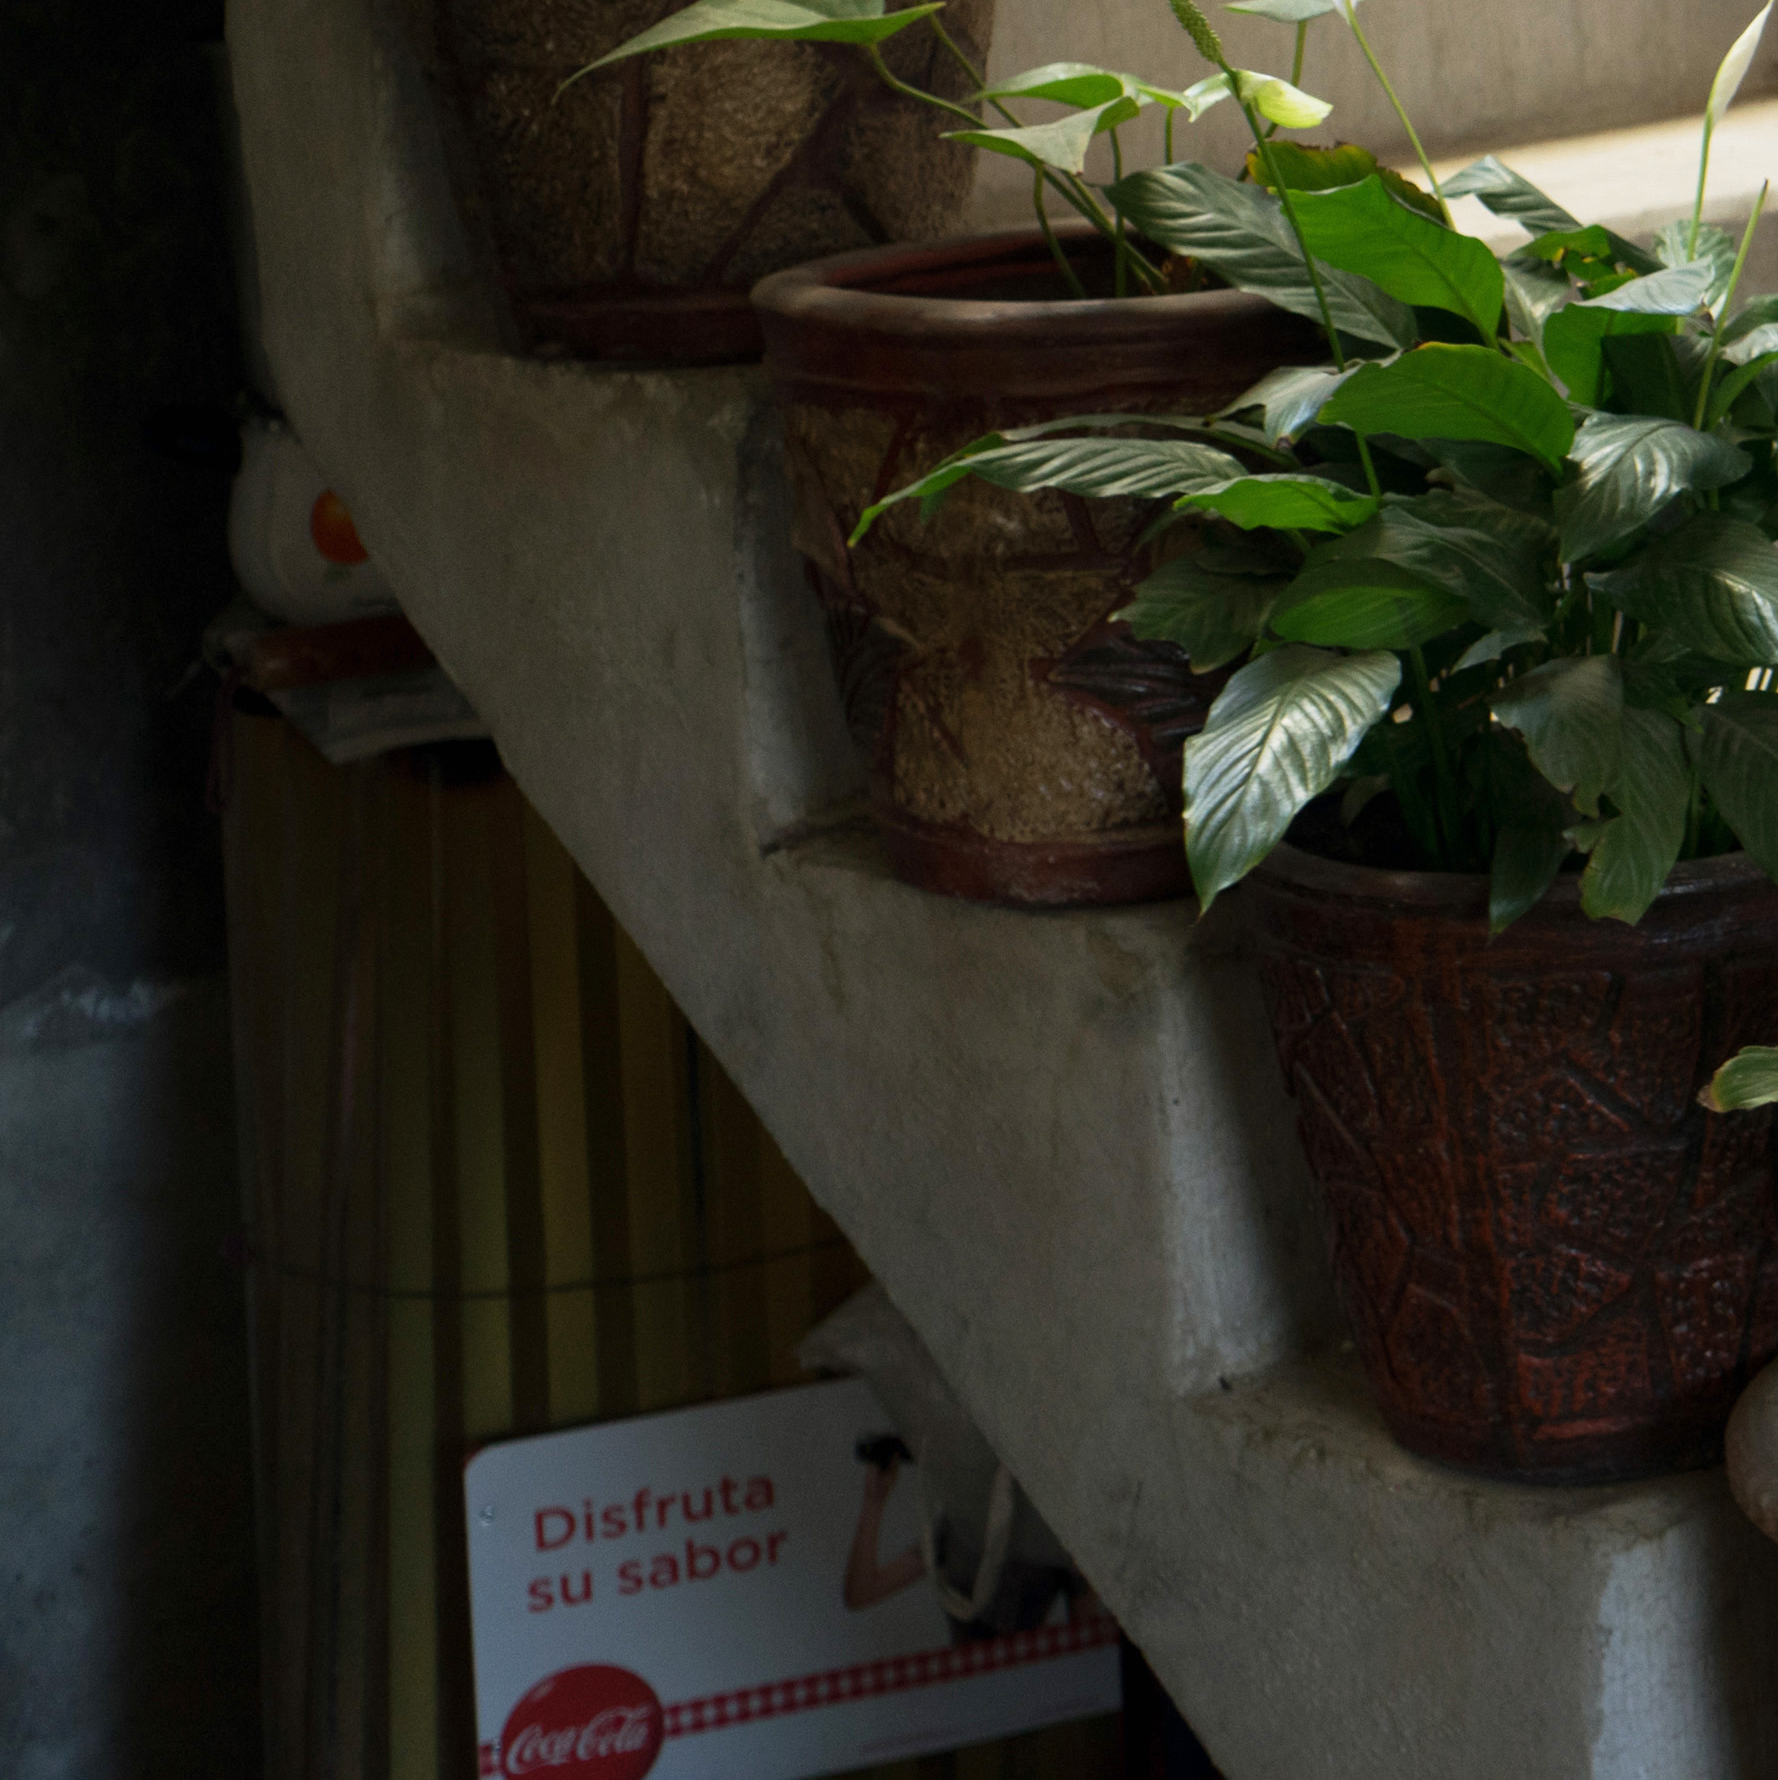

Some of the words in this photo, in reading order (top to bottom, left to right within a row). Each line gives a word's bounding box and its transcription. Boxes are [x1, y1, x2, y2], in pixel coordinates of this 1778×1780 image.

[534, 1474, 775, 1552] Disfruta
[527, 1569, 593, 1614] su
[617, 1530, 788, 1596] sabor
